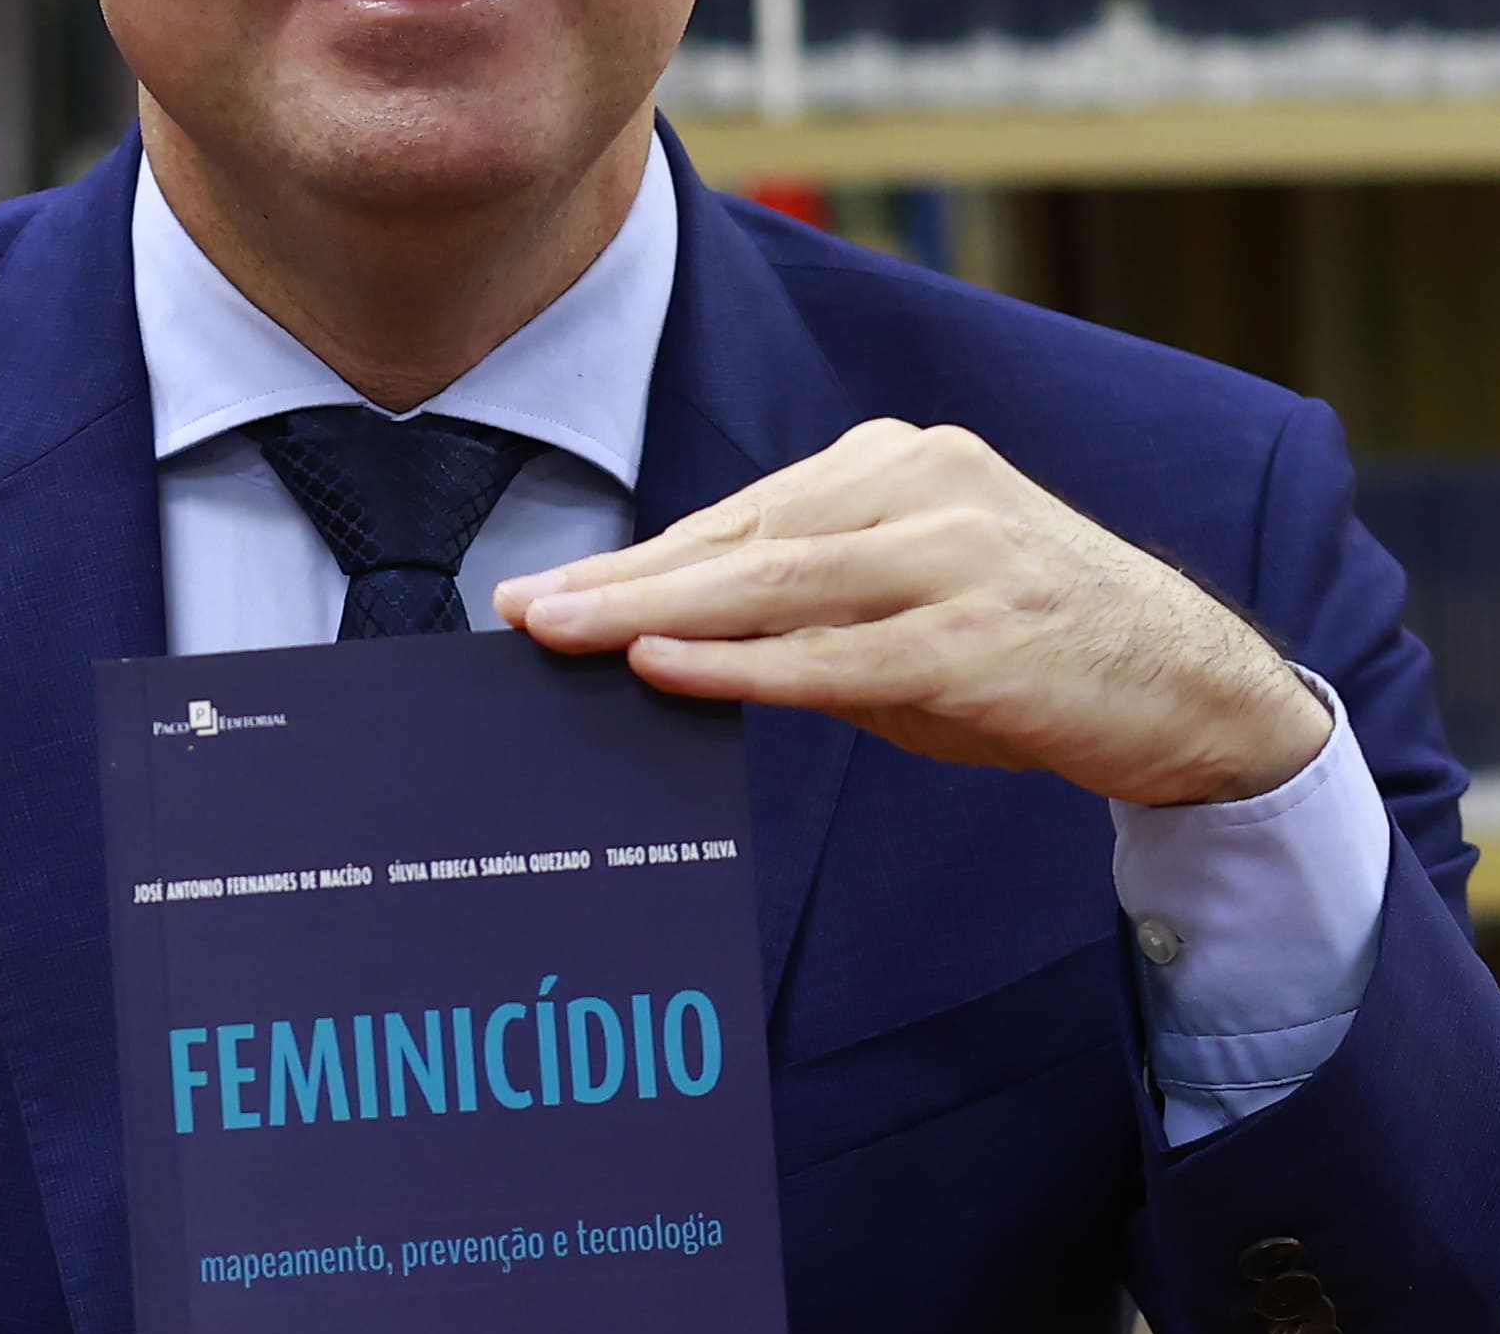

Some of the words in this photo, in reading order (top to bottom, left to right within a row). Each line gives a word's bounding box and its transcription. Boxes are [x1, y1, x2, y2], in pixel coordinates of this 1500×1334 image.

[431, 858, 477, 880] REBECA
[530, 850, 590, 873] QUEZADO
[606, 846, 645, 866] TIAGO
[649, 843, 678, 864] DIAS
[681, 842, 699, 861] DA
[702, 839, 737, 860] SILVA
[133, 878, 162, 904] JOSÉ
[166, 878, 223, 900] ANTONIO
[227, 872, 298, 895] FERNANDES
[300, 870, 317, 890] DE
[169, 975, 722, 1134] FEMINICÍDIO
[200, 1236, 394, 1289] mapeamento,
[402, 1227, 544, 1276] prevenção
[553, 1230, 569, 1258] e
[577, 1212, 723, 1260] tecnologia
